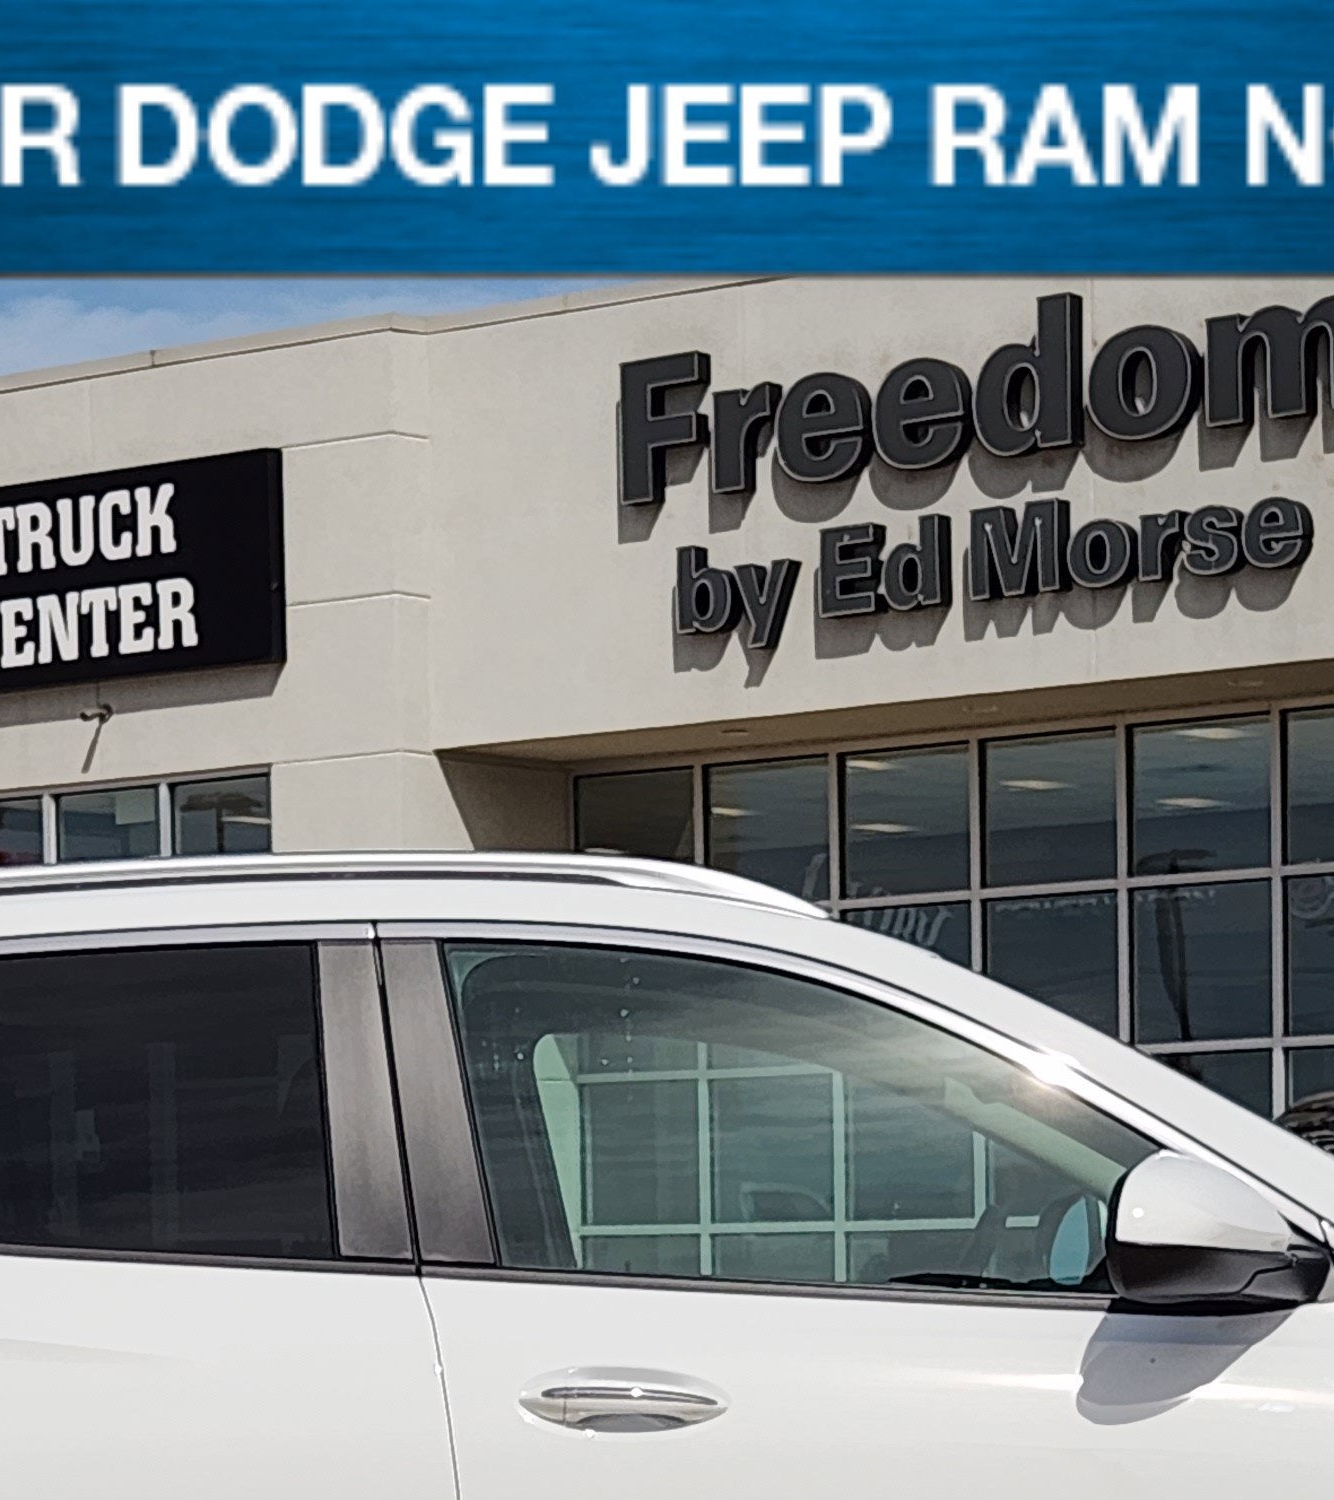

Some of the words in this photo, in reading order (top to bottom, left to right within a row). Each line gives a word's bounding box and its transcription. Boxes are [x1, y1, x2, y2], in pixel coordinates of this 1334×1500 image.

[675, 545, 800, 649] by
[818, 513, 953, 620] Ed
[970, 496, 1314, 603] Morse
